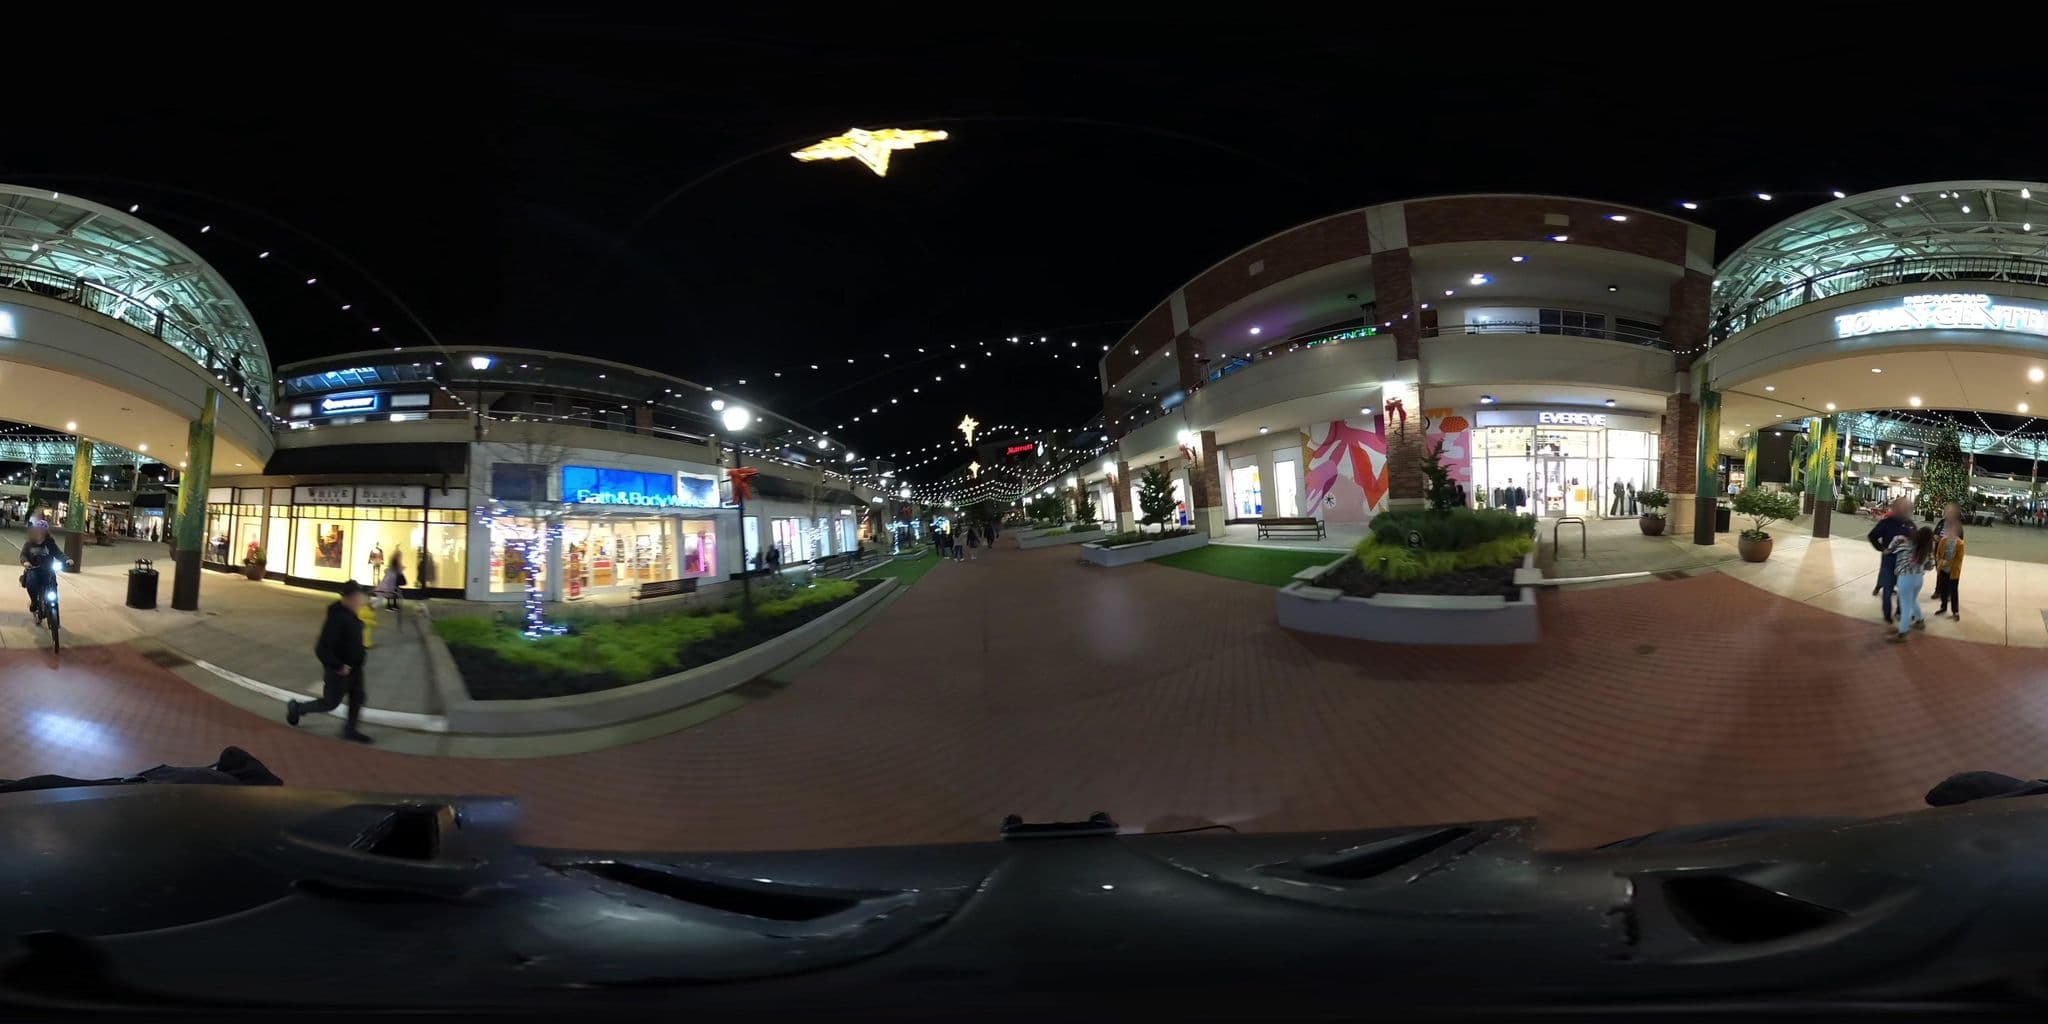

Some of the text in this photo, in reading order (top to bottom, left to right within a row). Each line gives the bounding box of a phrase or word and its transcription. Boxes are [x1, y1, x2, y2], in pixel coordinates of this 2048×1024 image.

[1903, 293, 1989, 305] REDMOND
[1835, 307, 1928, 338] TOWN
[1539, 412, 1606, 427] EVEREVE
[617, 491, 629, 506] &
[629, 492, 666, 508] Body
